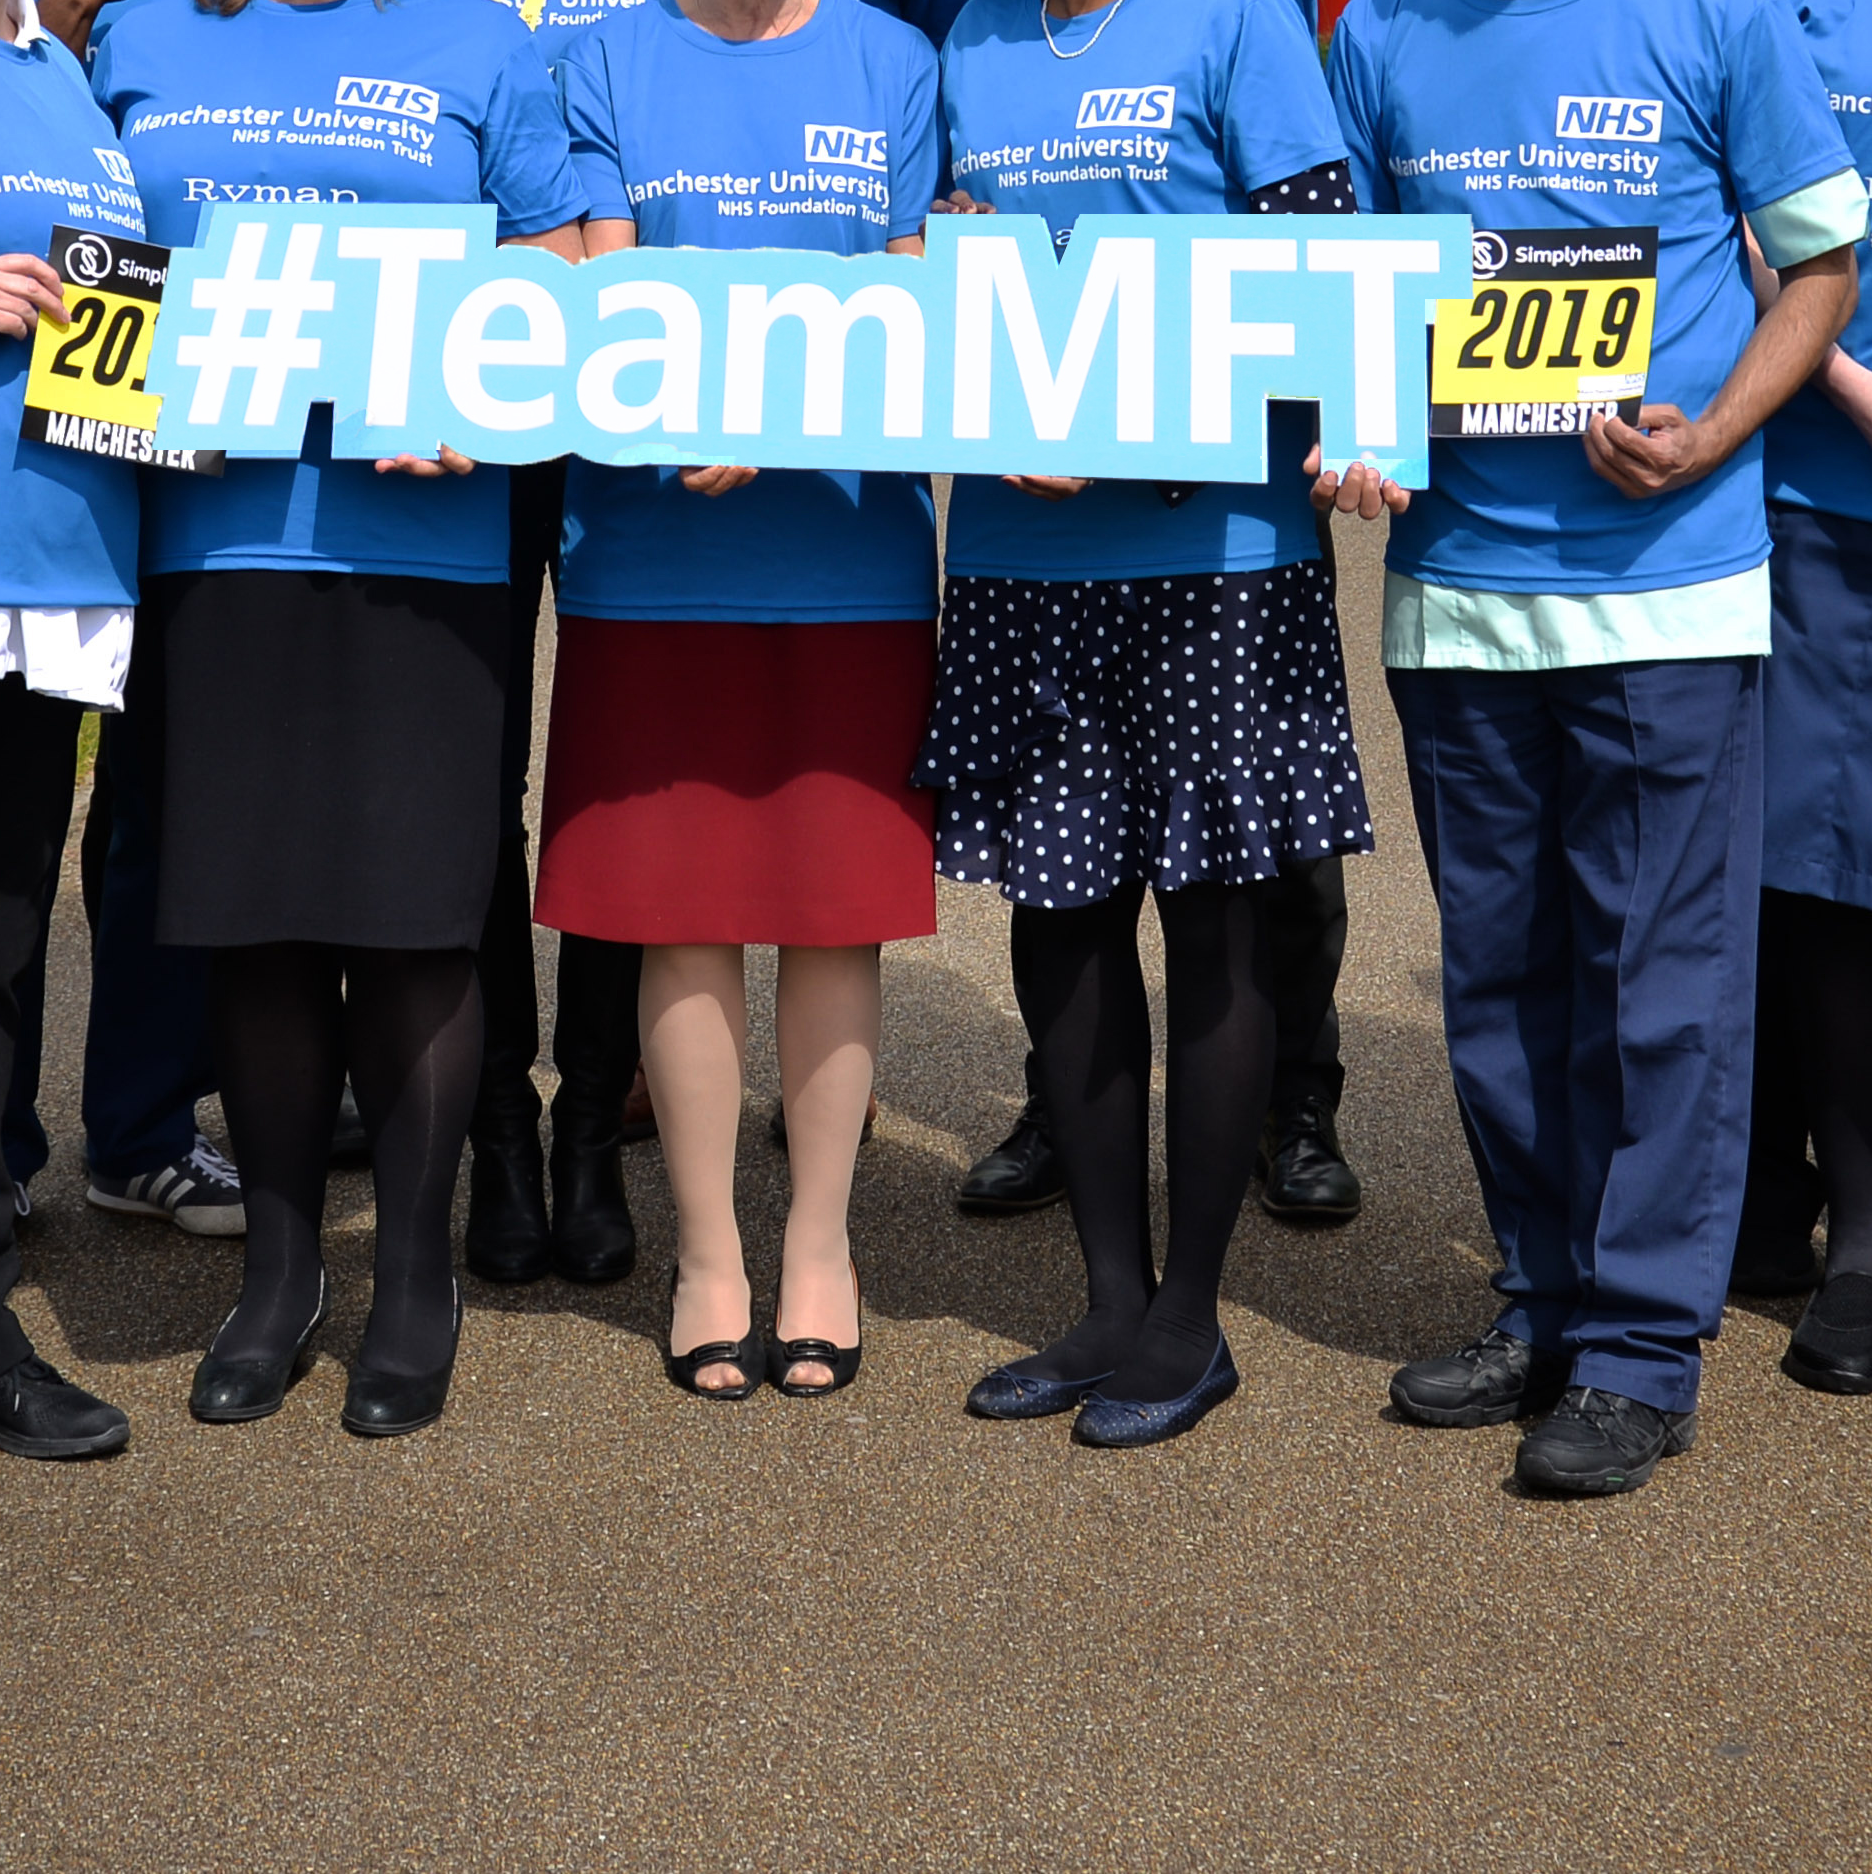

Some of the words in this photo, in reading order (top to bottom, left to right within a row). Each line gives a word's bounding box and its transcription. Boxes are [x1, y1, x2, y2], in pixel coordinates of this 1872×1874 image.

[340, 80, 435, 116] NHS
[1079, 89, 1171, 124] NHS
[130, 104, 284, 138] Manchester
[293, 106, 435, 150] University
[1560, 101, 1658, 137] NHS
[232, 128, 271, 144] NHS
[276, 129, 386, 151] Foundation
[391, 140, 433, 168] Trust
[1041, 134, 1170, 165] University
[1517, 143, 1661, 180] University
[769, 168, 890, 210] University
[998, 172, 1028, 189] NHS
[1032, 163, 1123, 185] Foundation
[1126, 164, 1169, 182] Trust
[1464, 174, 1502, 191] NHS
[1507, 173, 1609, 195] Foundation
[1614, 178, 1660, 197] Trust
[66, 201, 95, 220] NHS
[717, 199, 754, 217] NHS
[758, 197, 857, 218] Foundation
[1515, 243, 1643, 267] Simplyhealth
[175, 222, 1441, 447] #TeamMFT
[1457, 286, 1642, 370] 2019
